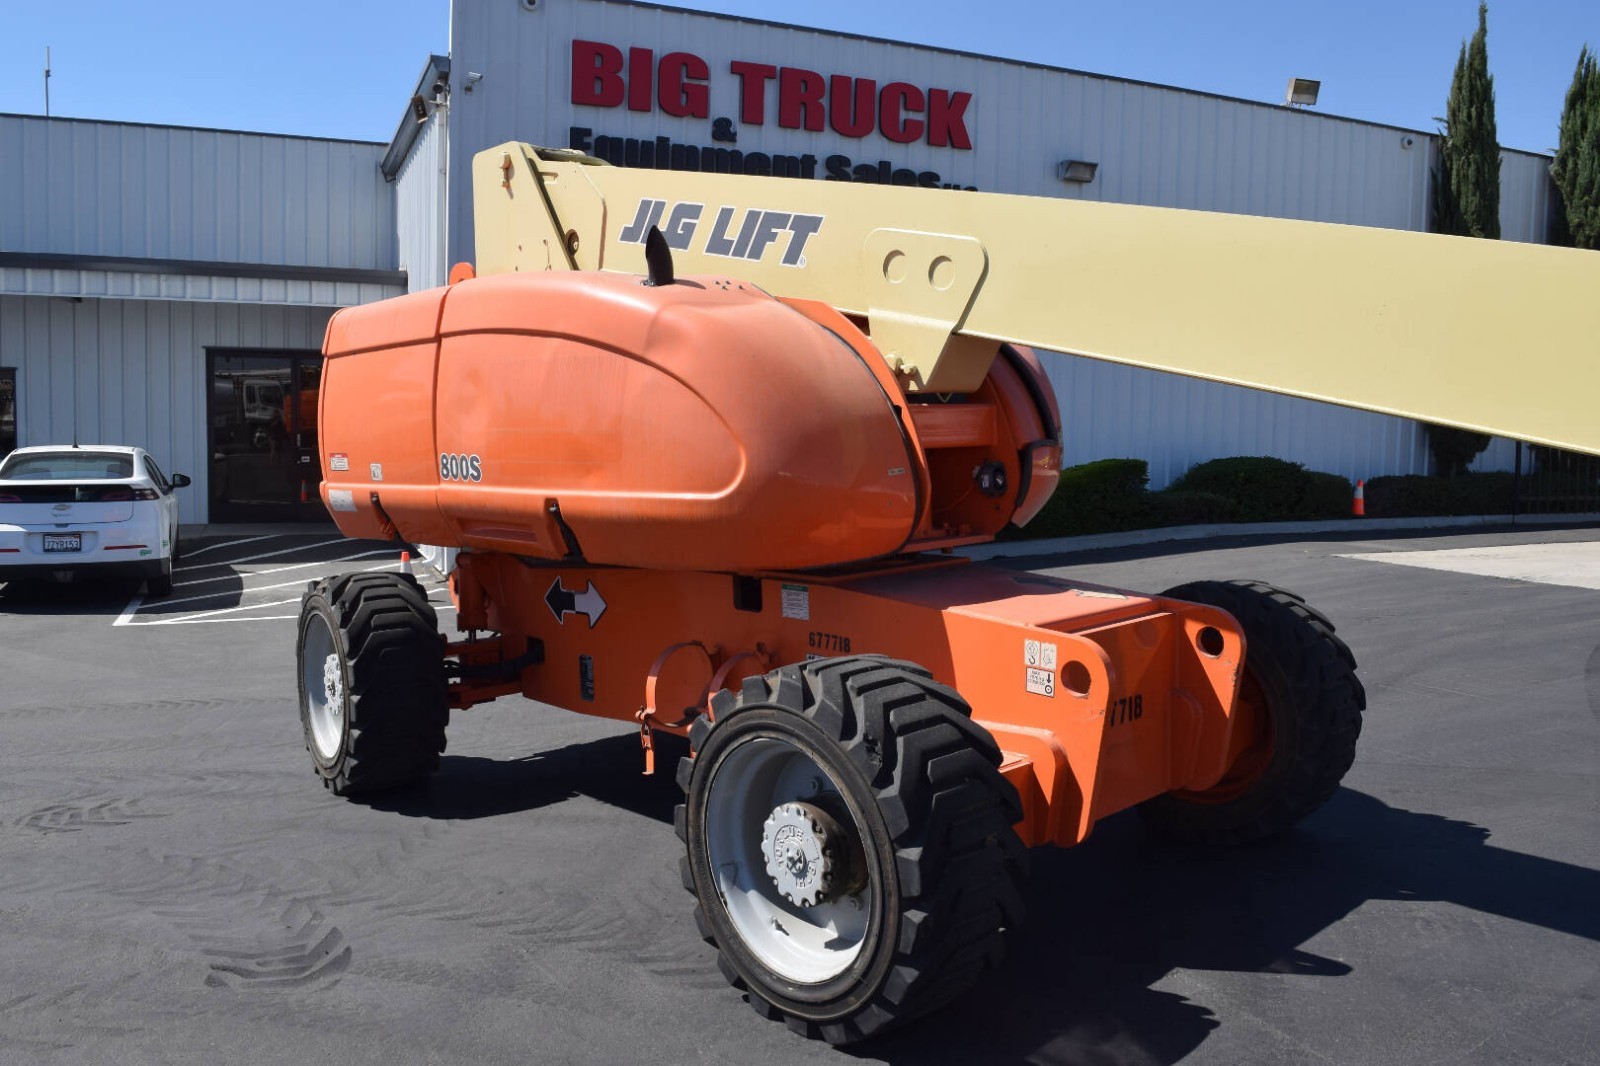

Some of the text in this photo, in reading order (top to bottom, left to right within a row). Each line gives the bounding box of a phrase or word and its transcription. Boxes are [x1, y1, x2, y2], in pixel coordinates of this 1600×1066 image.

[571, 39, 973, 150] BIG TRUCK
[712, 117, 737, 143] &
[618, 197, 826, 267] JLG LIFT
[440, 453, 482, 482] 800S
[808, 632, 851, 653] 677718
